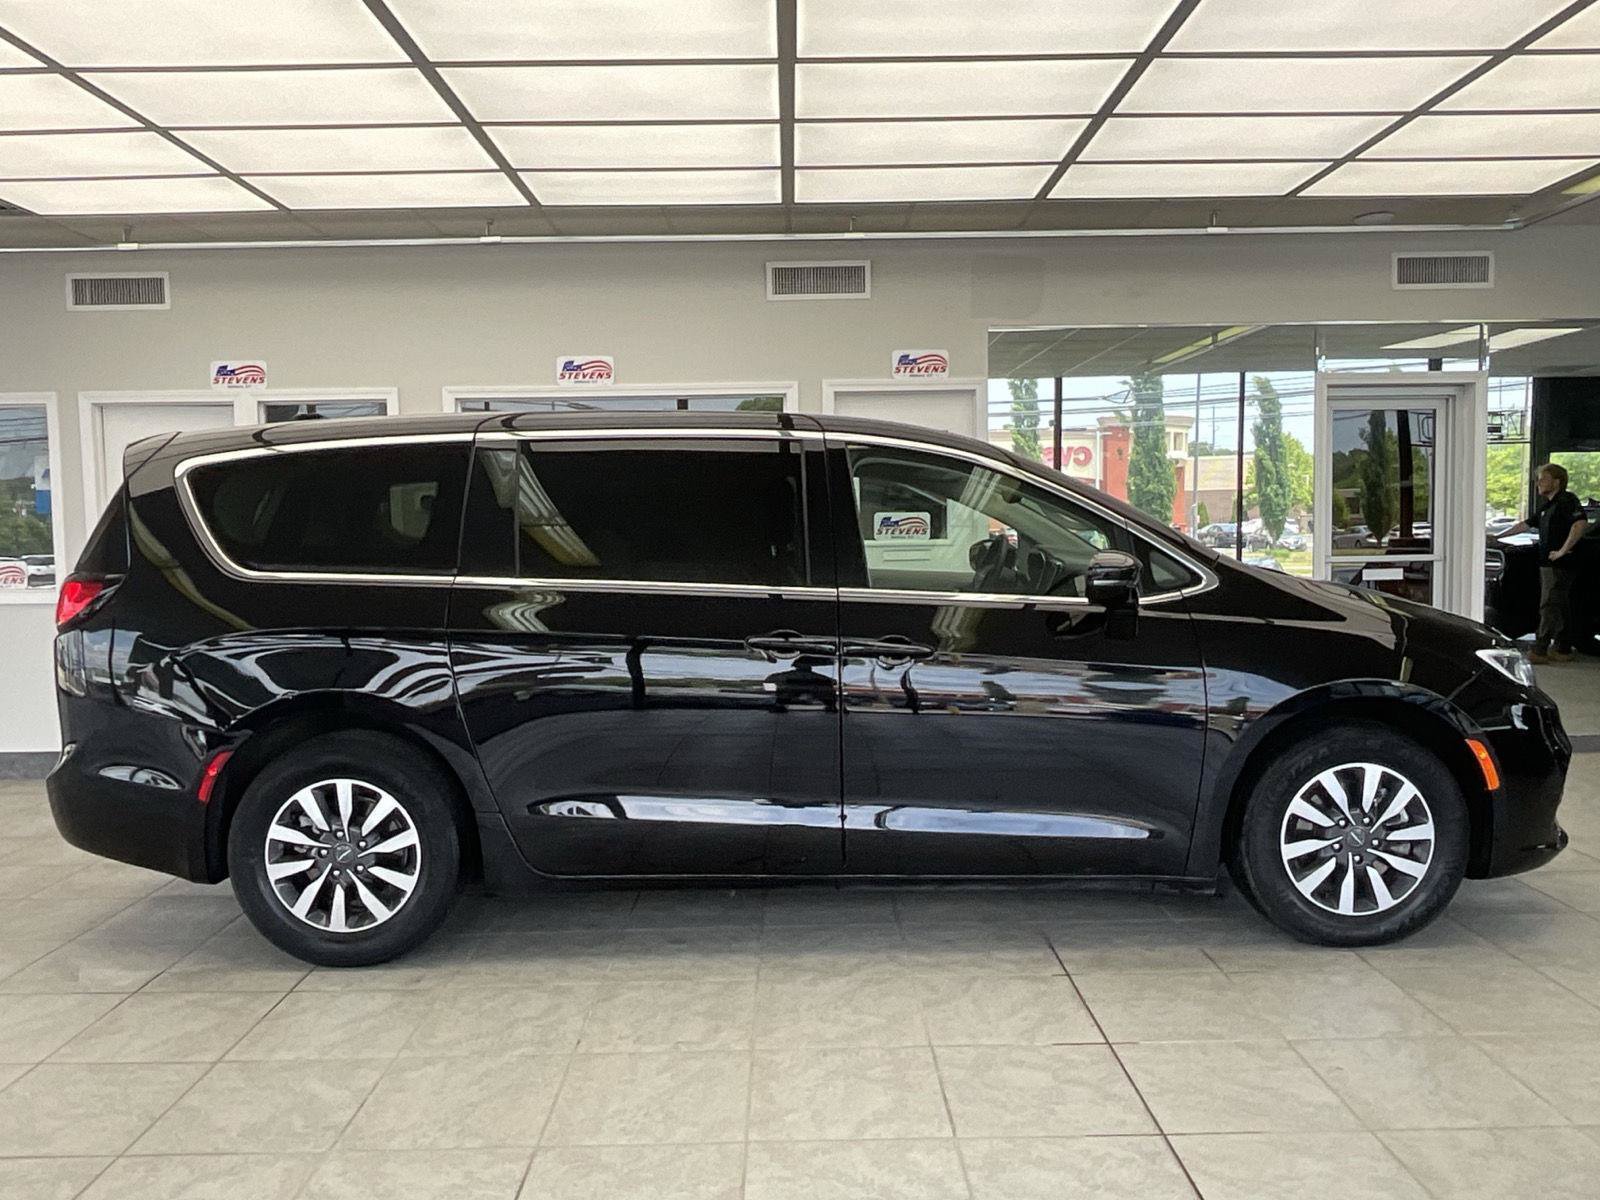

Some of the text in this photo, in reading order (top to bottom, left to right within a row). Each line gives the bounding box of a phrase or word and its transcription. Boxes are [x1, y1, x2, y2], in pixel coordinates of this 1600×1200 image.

[894, 365, 947, 374] STEVENS
[559, 371, 612, 380] STEVENS
[212, 376, 265, 385] STEVENS
[876, 527, 928, 535] STEVENS
